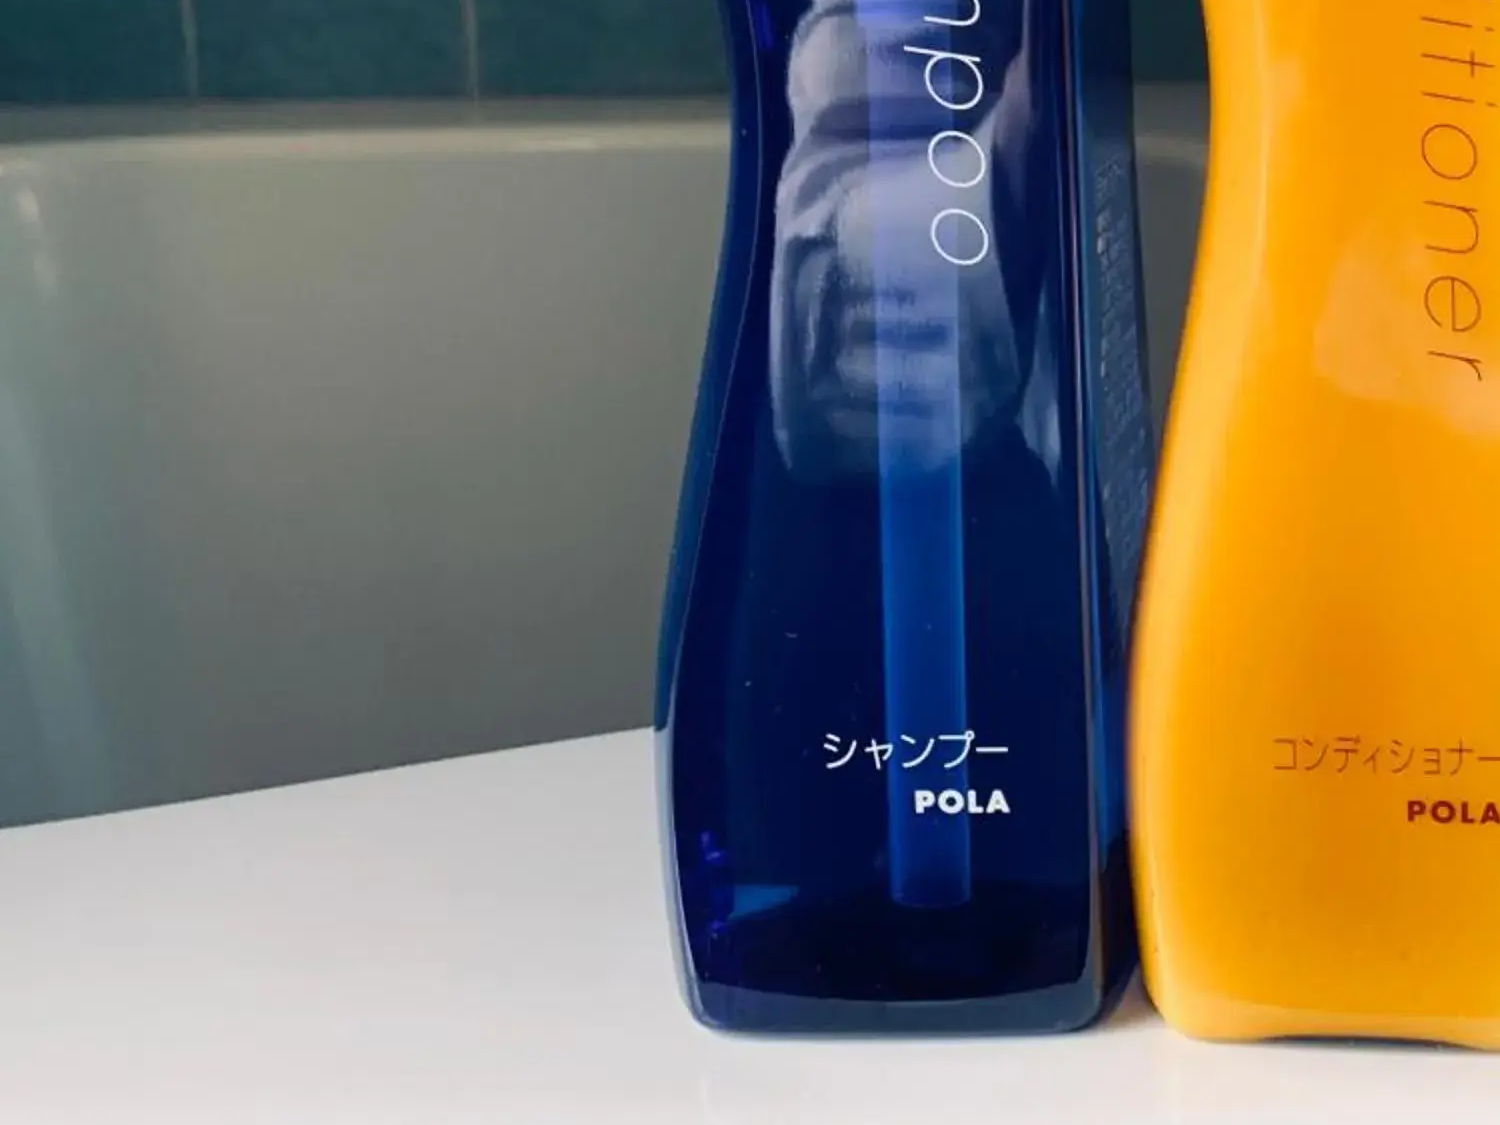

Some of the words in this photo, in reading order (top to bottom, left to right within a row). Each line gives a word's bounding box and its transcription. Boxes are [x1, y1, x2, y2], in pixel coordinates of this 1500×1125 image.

[823, 729, 1009, 770] シャンプー
[914, 789, 1011, 814] POLA
